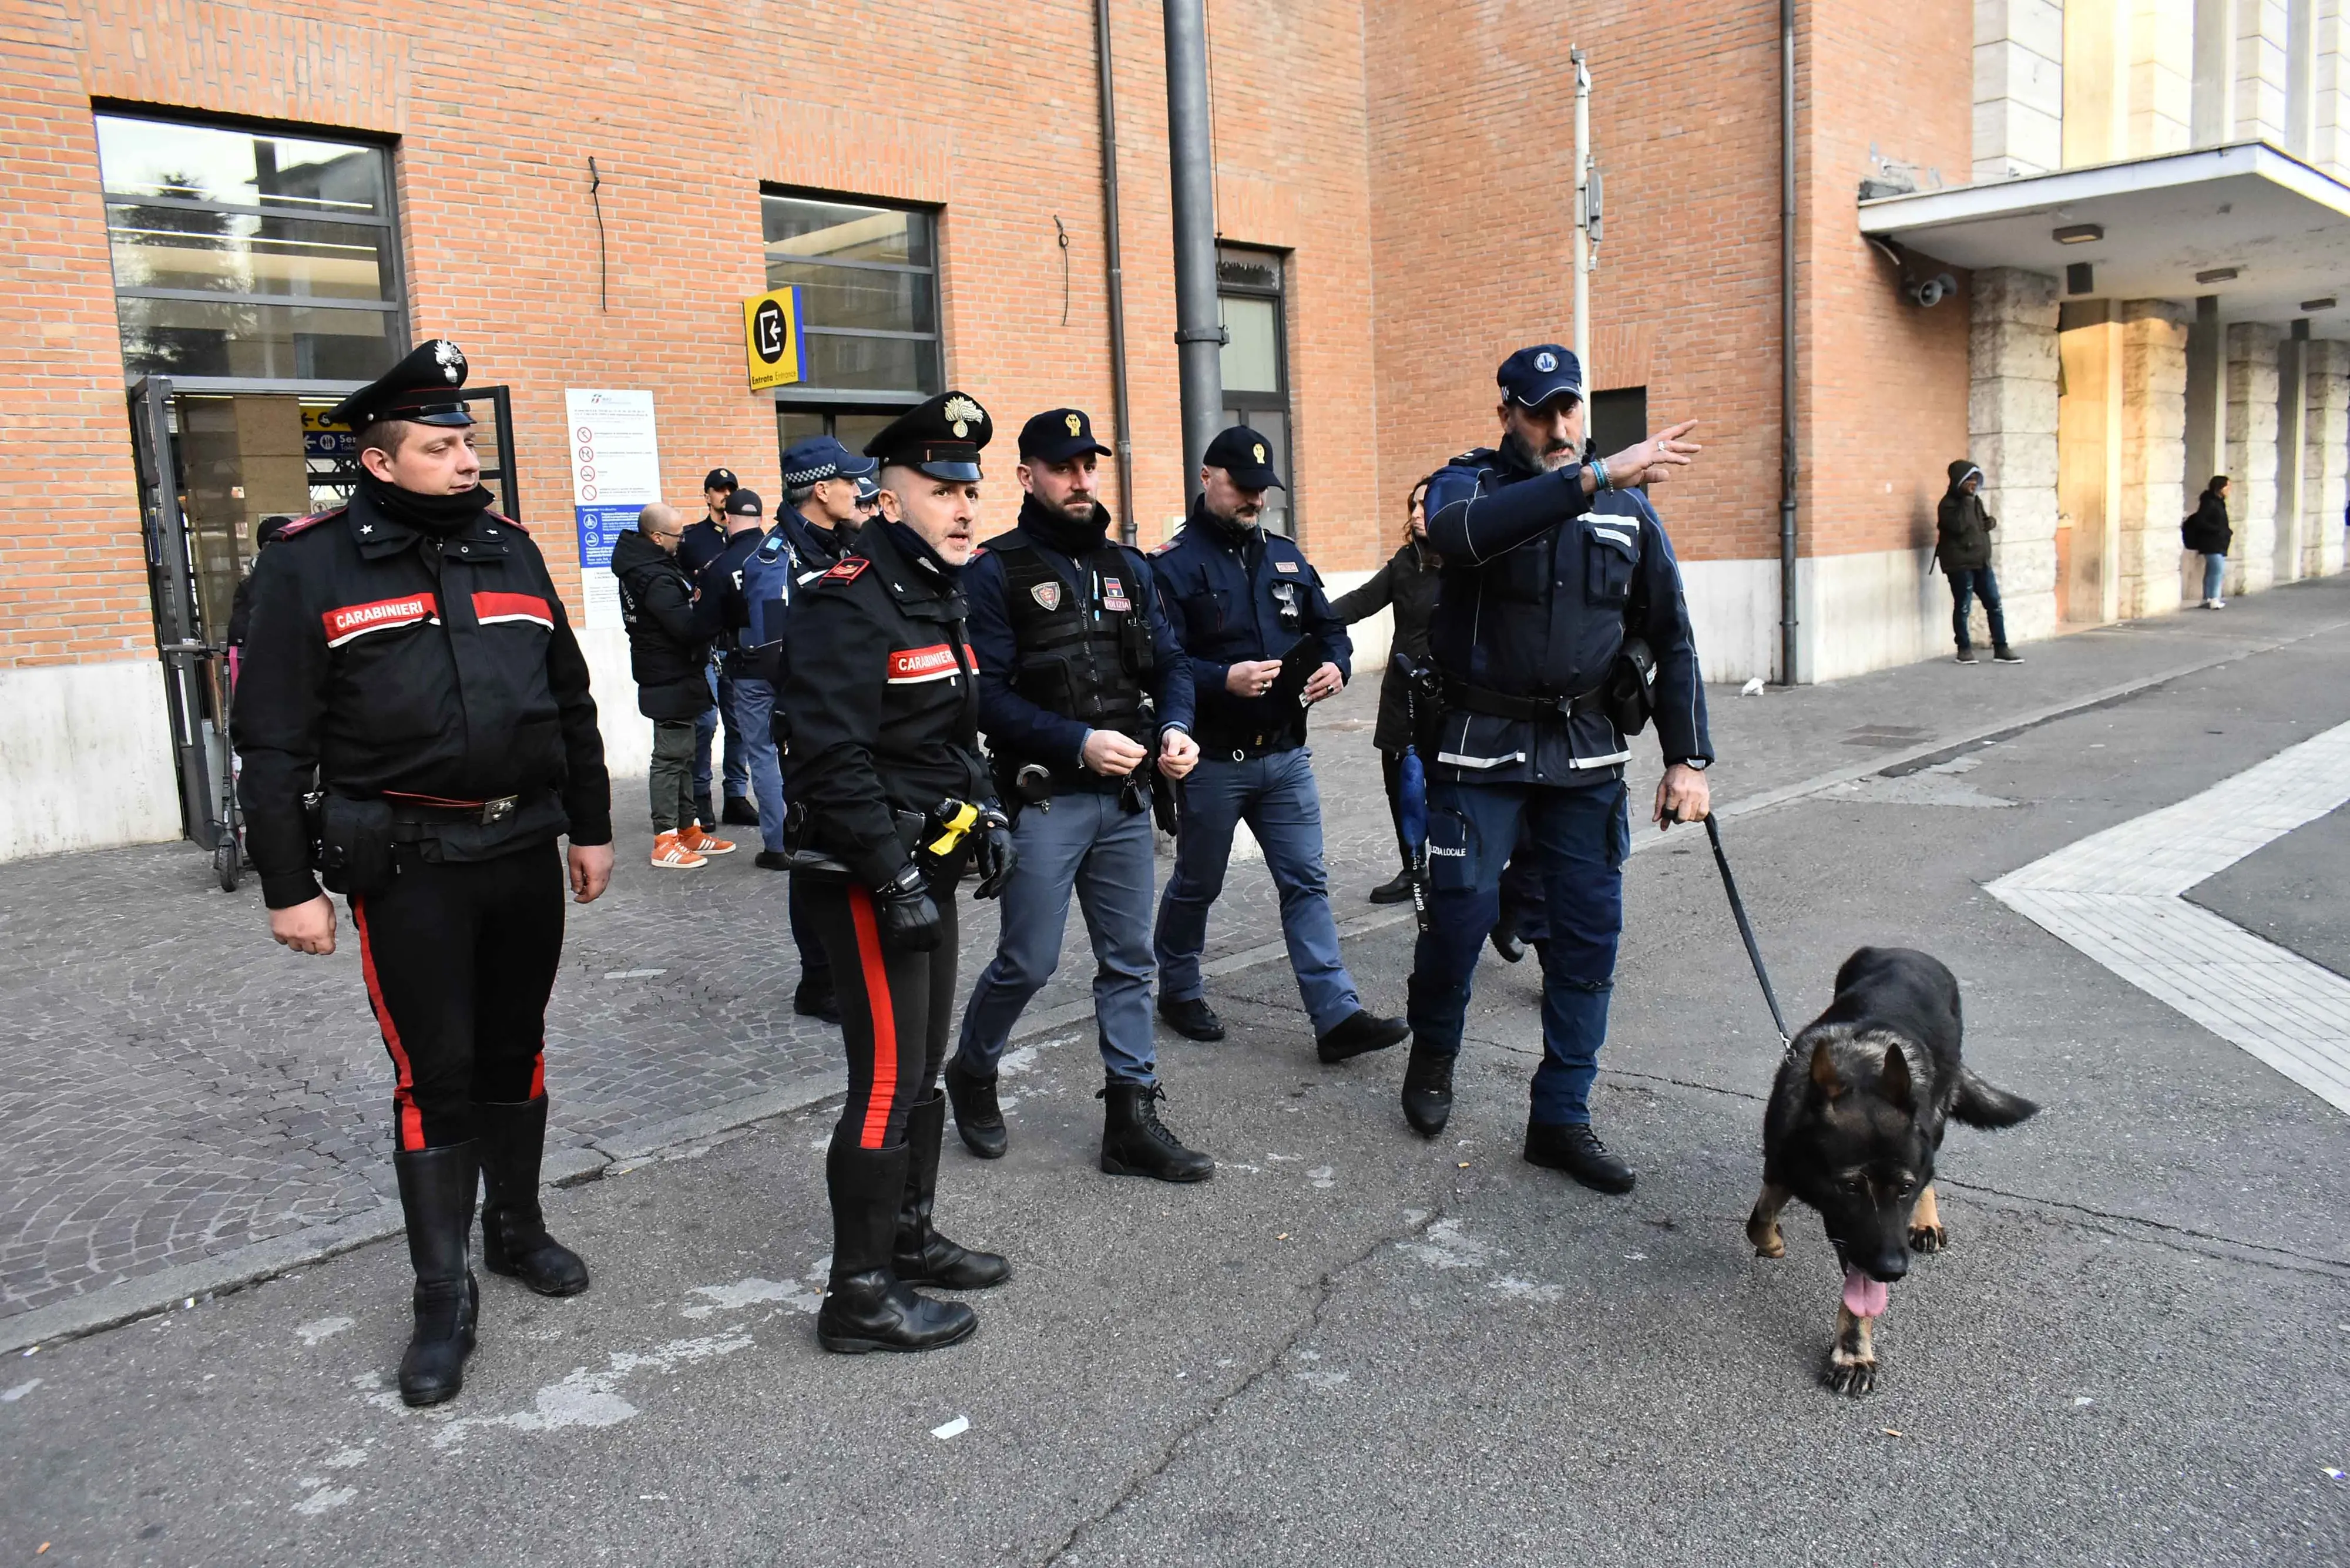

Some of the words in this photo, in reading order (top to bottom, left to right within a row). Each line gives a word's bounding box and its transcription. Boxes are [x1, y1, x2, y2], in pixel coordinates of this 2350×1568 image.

[752, 375, 773, 384] Entrata
[775, 371, 797, 380] Entrance
[340, 435, 356, 444] Ser
[1105, 599, 1129, 609] POLIZIA
[336, 600, 424, 628] CARABINIERI
[1429, 845, 1443, 855] LIZIA
[1443, 848, 1466, 857] LOCALE
[1413, 882, 1425, 911] GAPPAY
